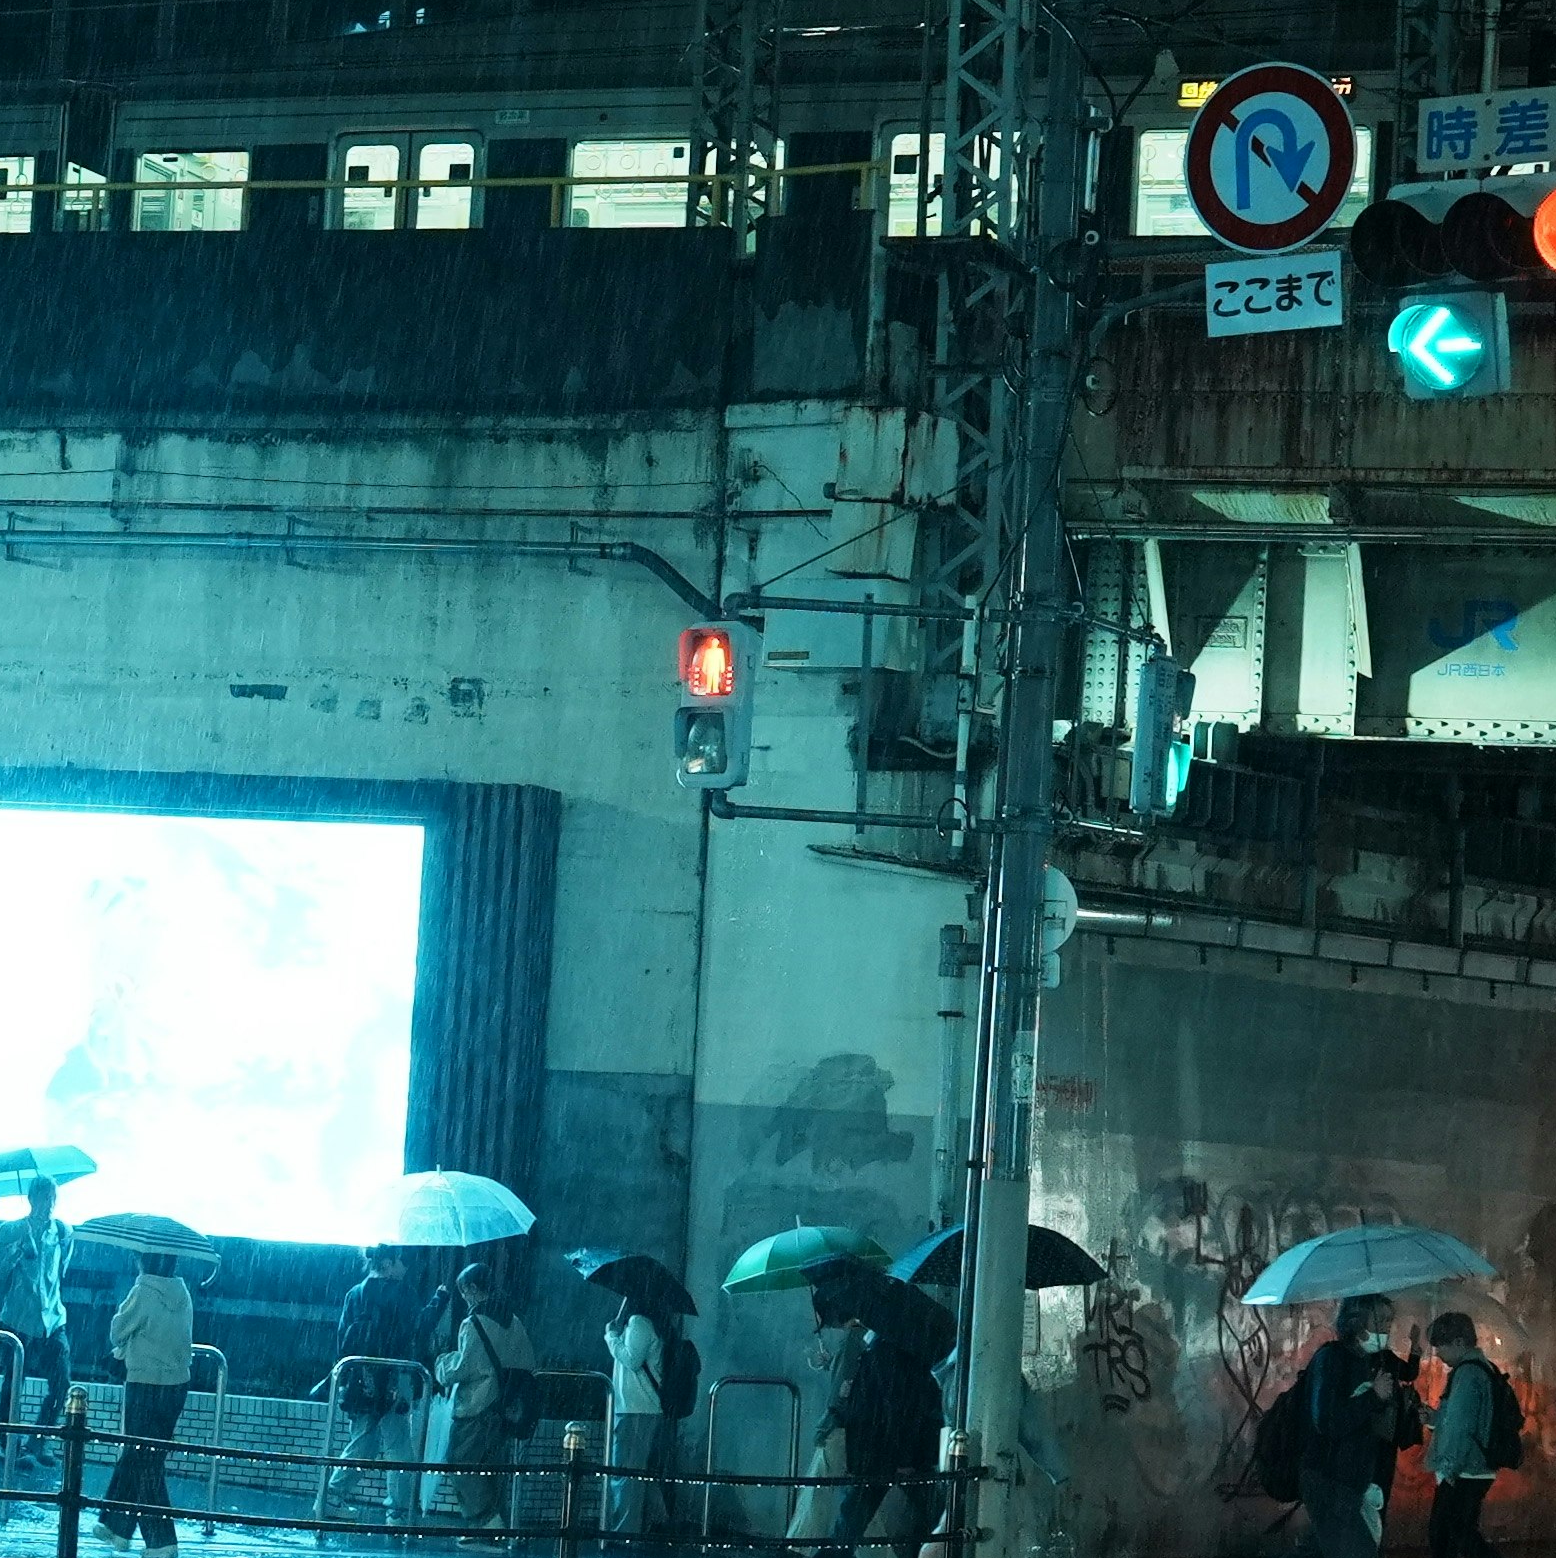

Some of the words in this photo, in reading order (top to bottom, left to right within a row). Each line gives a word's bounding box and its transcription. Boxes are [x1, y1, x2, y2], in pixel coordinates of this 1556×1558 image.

[1213, 270, 1336, 318] ここまで
[1427, 600, 1519, 652] JR
[1437, 663, 1506, 677] JR西日本
